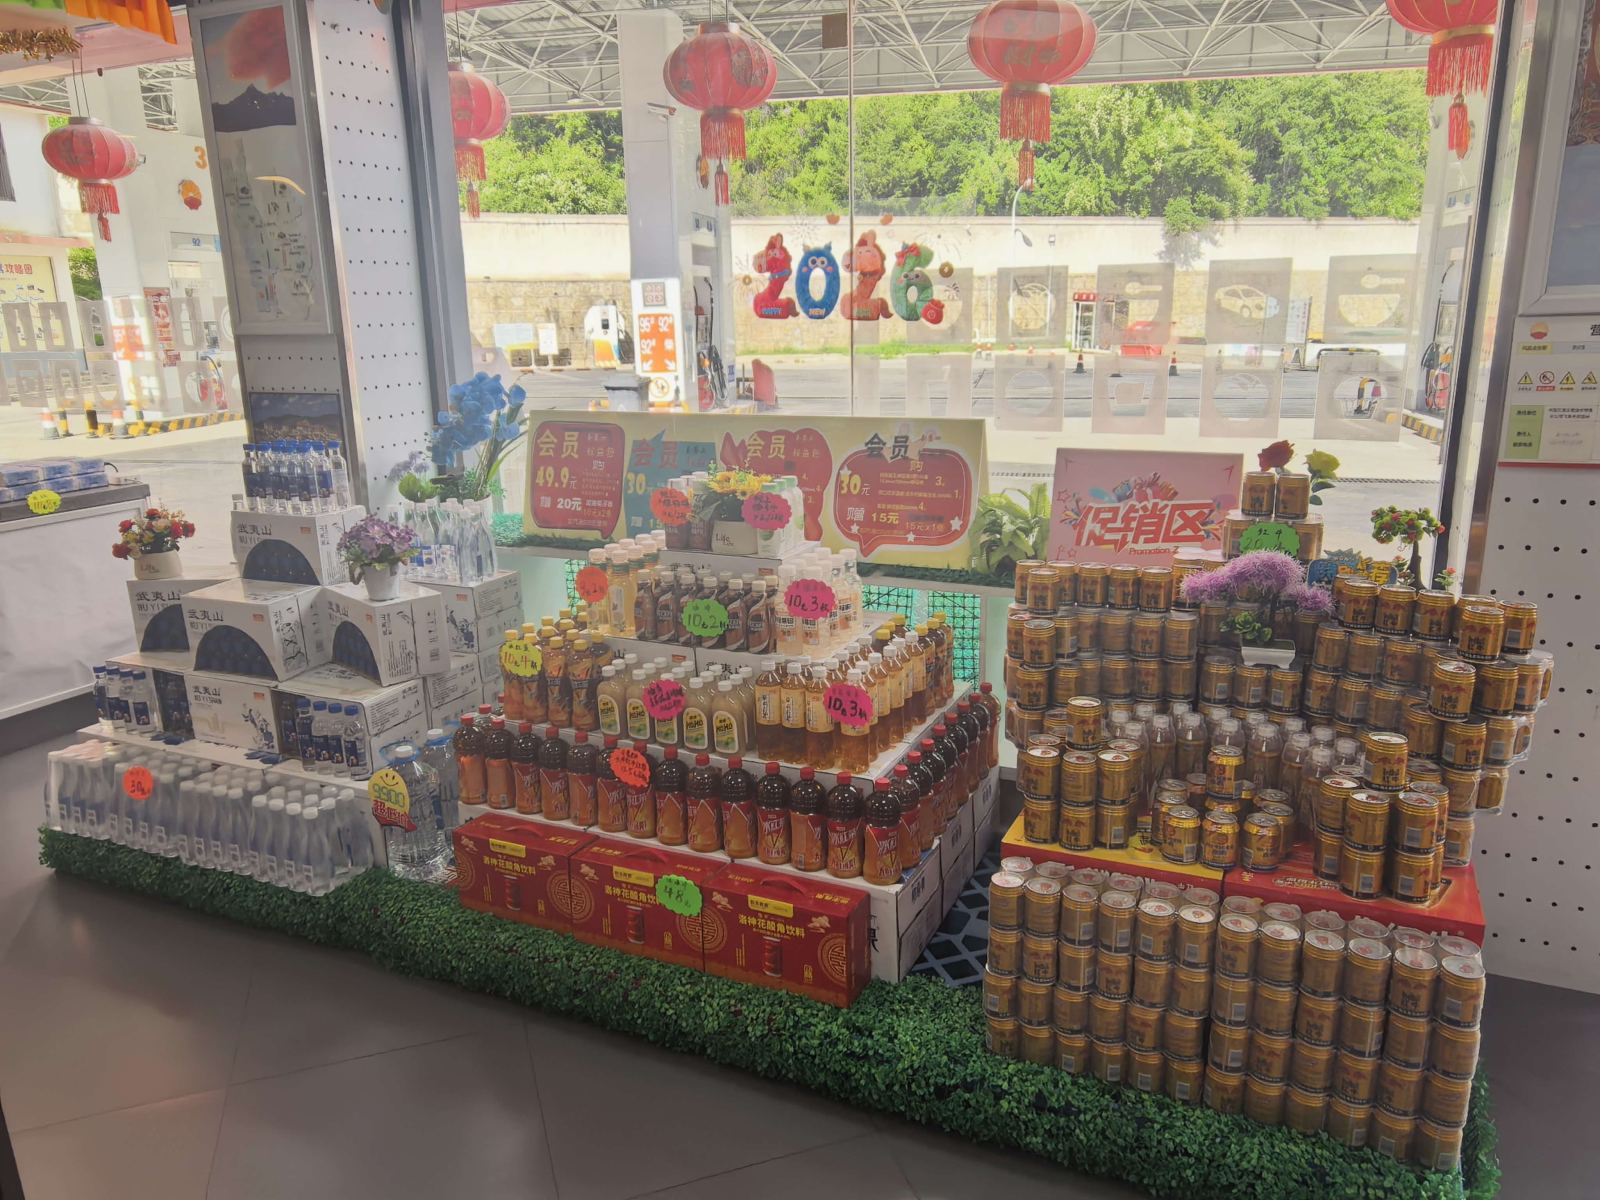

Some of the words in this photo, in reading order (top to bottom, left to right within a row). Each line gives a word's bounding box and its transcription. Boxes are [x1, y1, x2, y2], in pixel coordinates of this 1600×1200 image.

[537, 429, 580, 459] 会员
[634, 439, 678, 469] 会员
[747, 433, 786, 460] 会员
[864, 433, 909, 460] 会员
